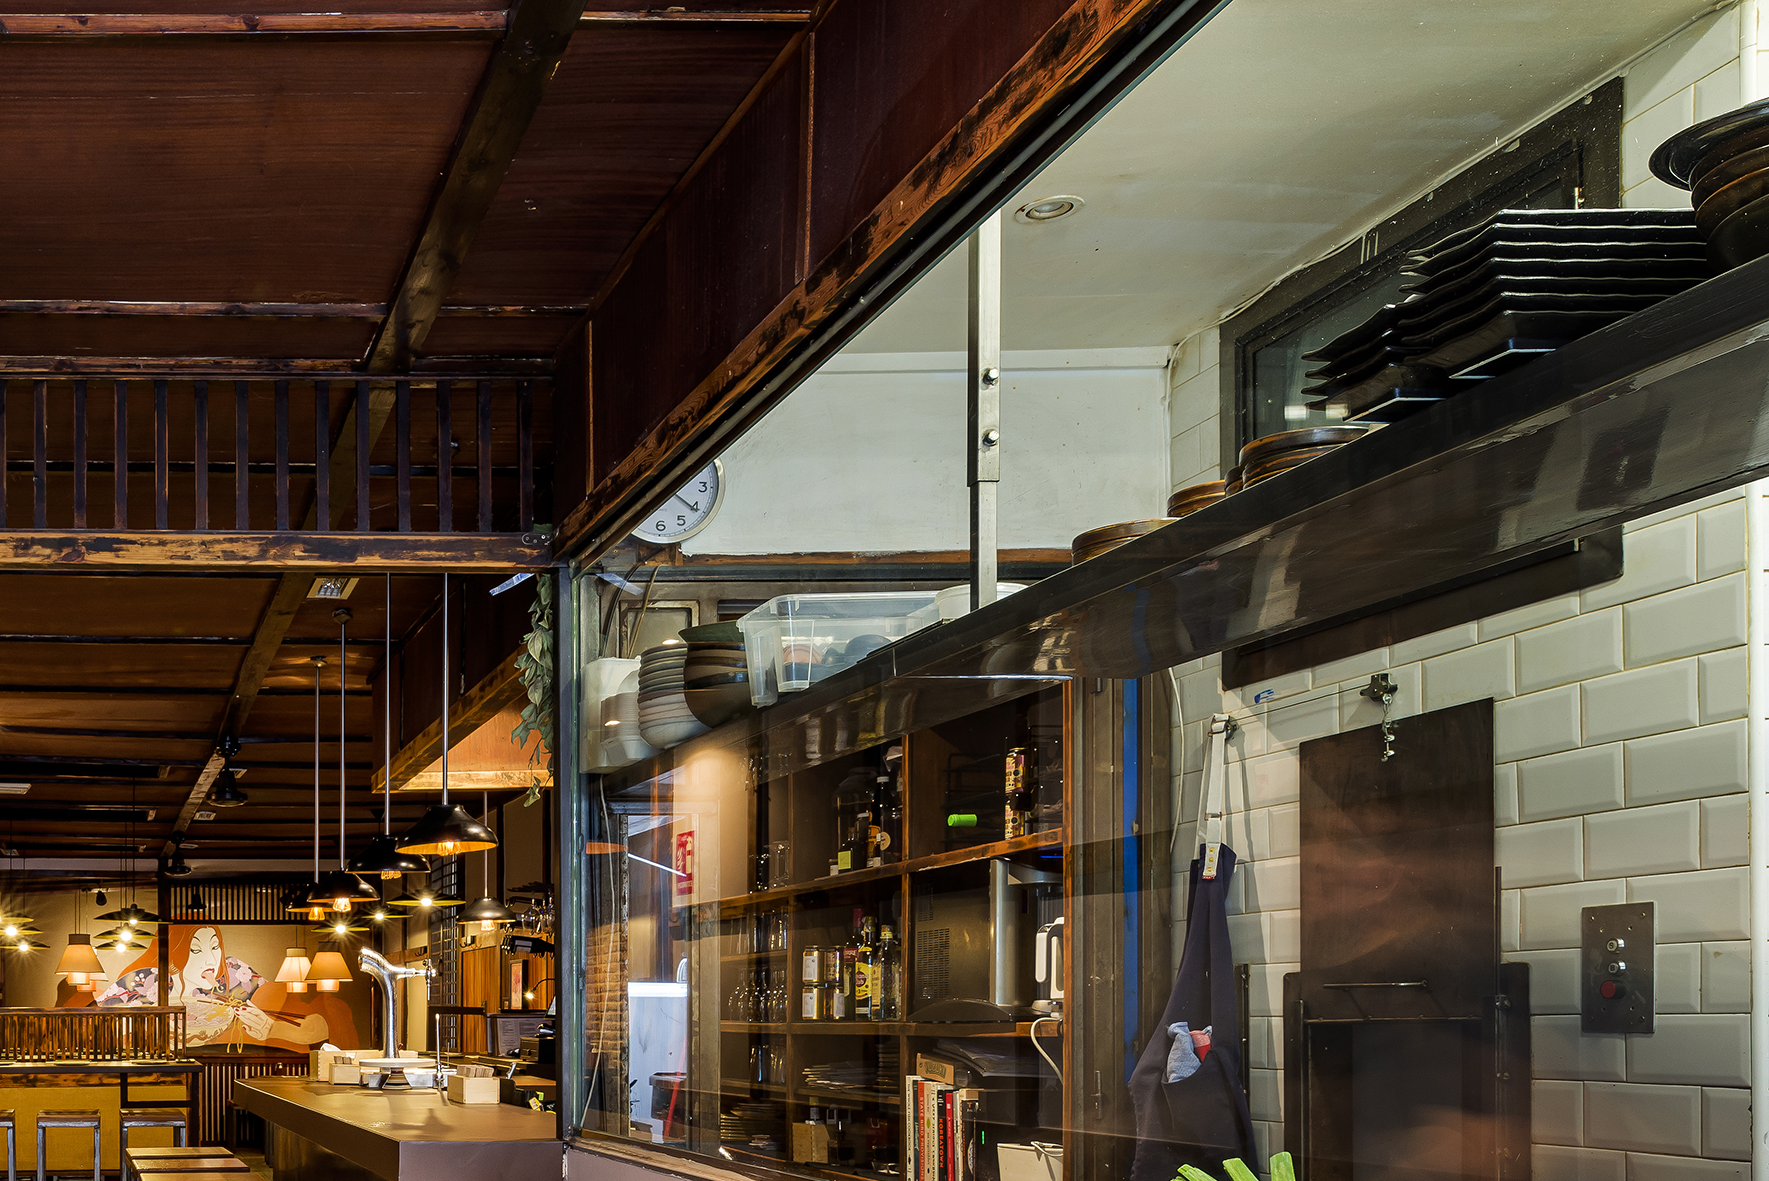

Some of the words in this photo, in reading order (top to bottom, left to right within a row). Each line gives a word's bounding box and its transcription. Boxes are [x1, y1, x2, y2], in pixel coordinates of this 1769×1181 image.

[699, 481, 708, 493] 3
[690, 501, 700, 512] 4
[677, 515, 686, 526] 5
[656, 521, 666, 532] 6
